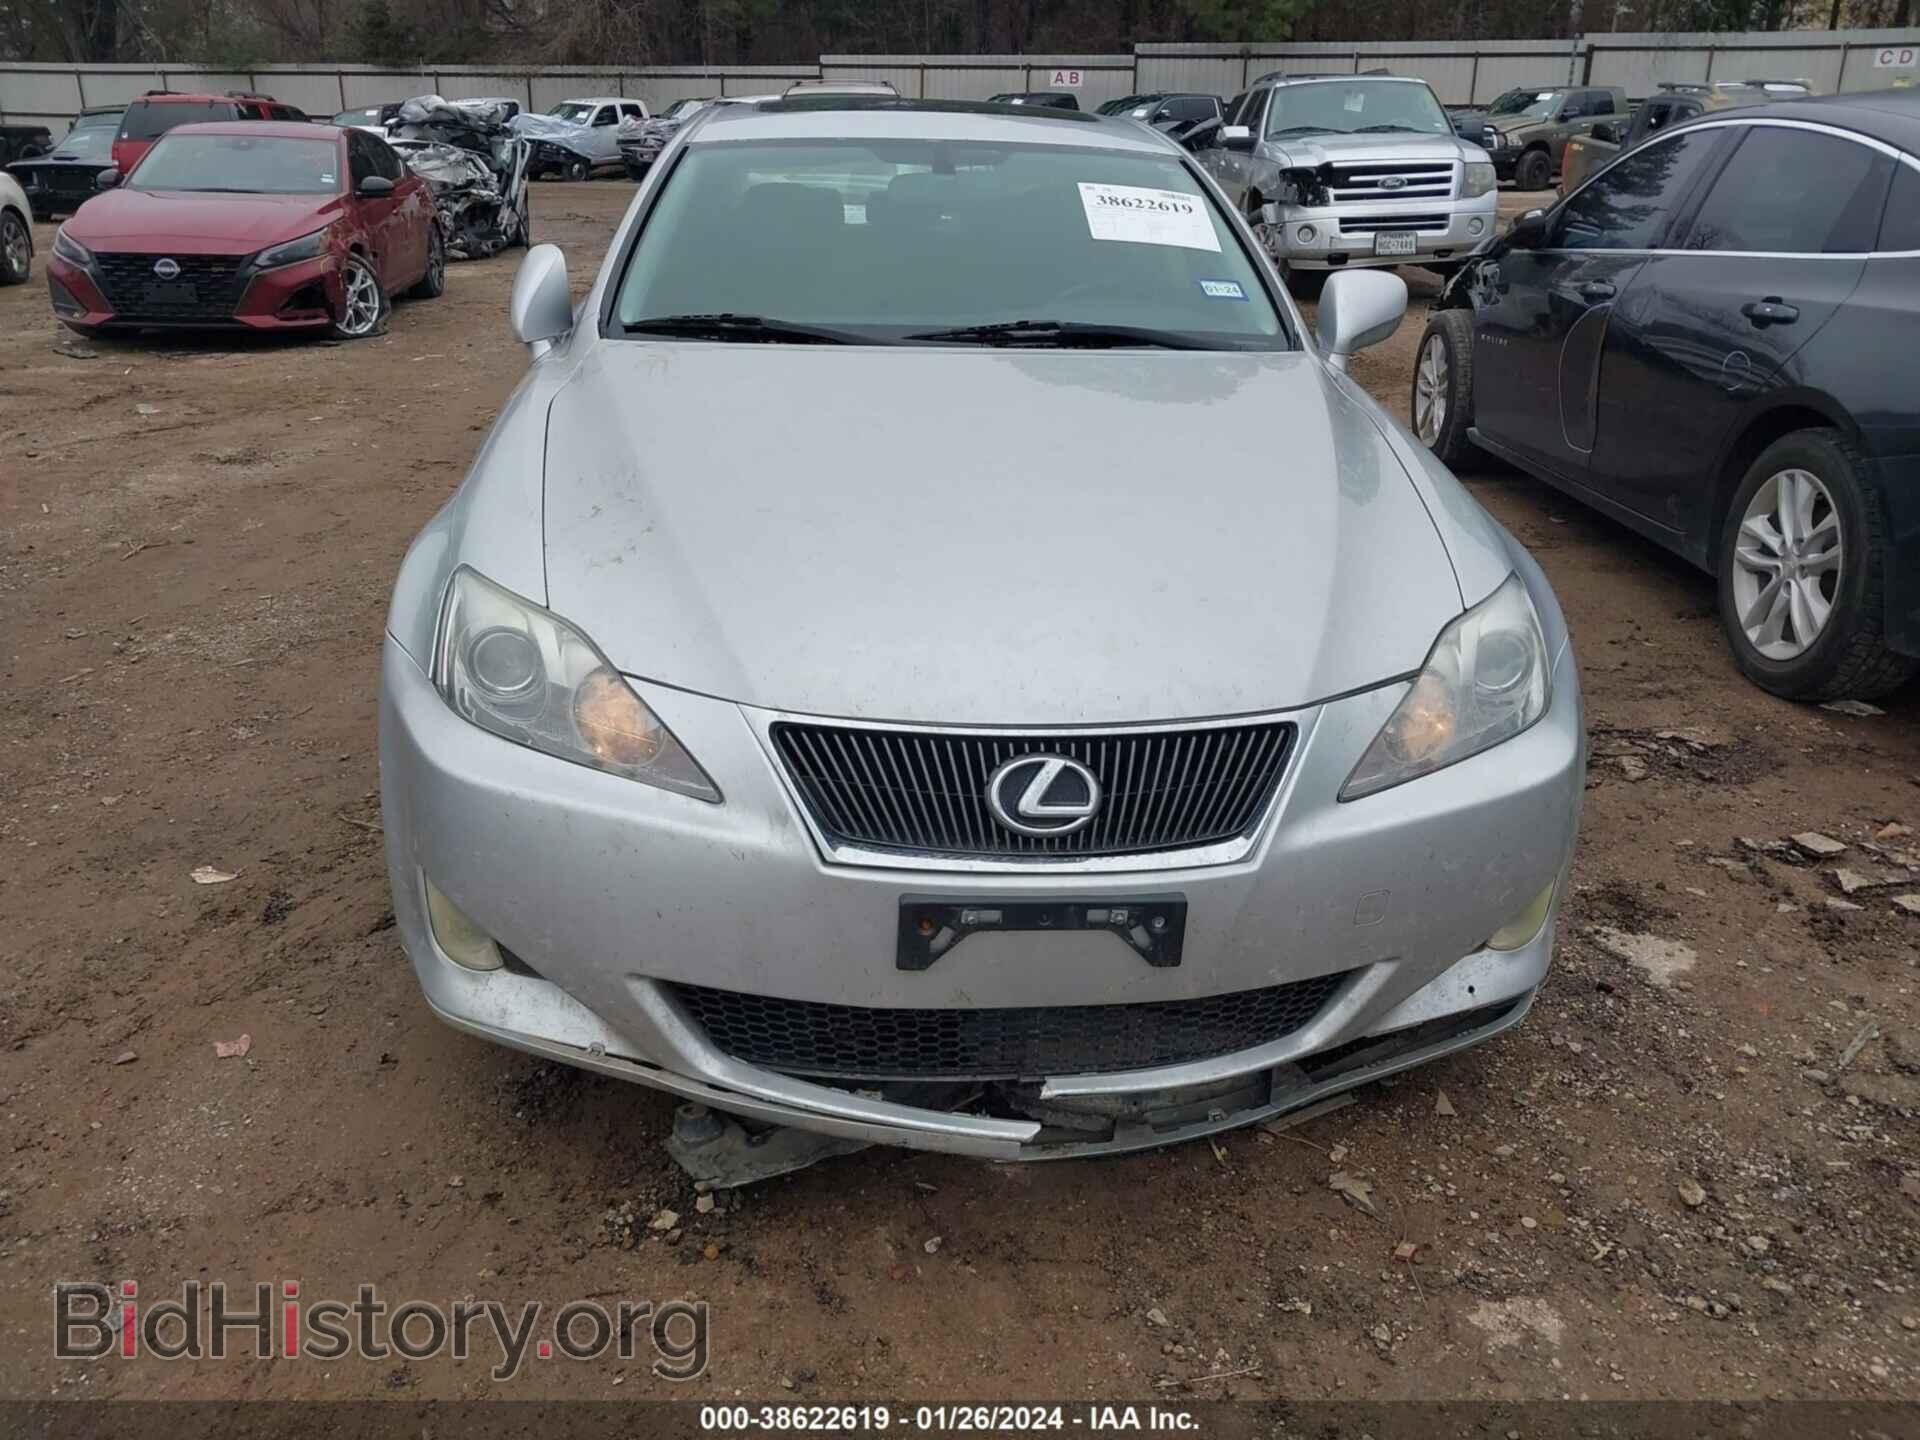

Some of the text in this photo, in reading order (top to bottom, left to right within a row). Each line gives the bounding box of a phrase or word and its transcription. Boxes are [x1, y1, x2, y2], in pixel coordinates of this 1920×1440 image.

[1880, 50, 1912, 65] C D
[1054, 71, 1080, 84] A B
[1096, 194, 1193, 214] 38622619
